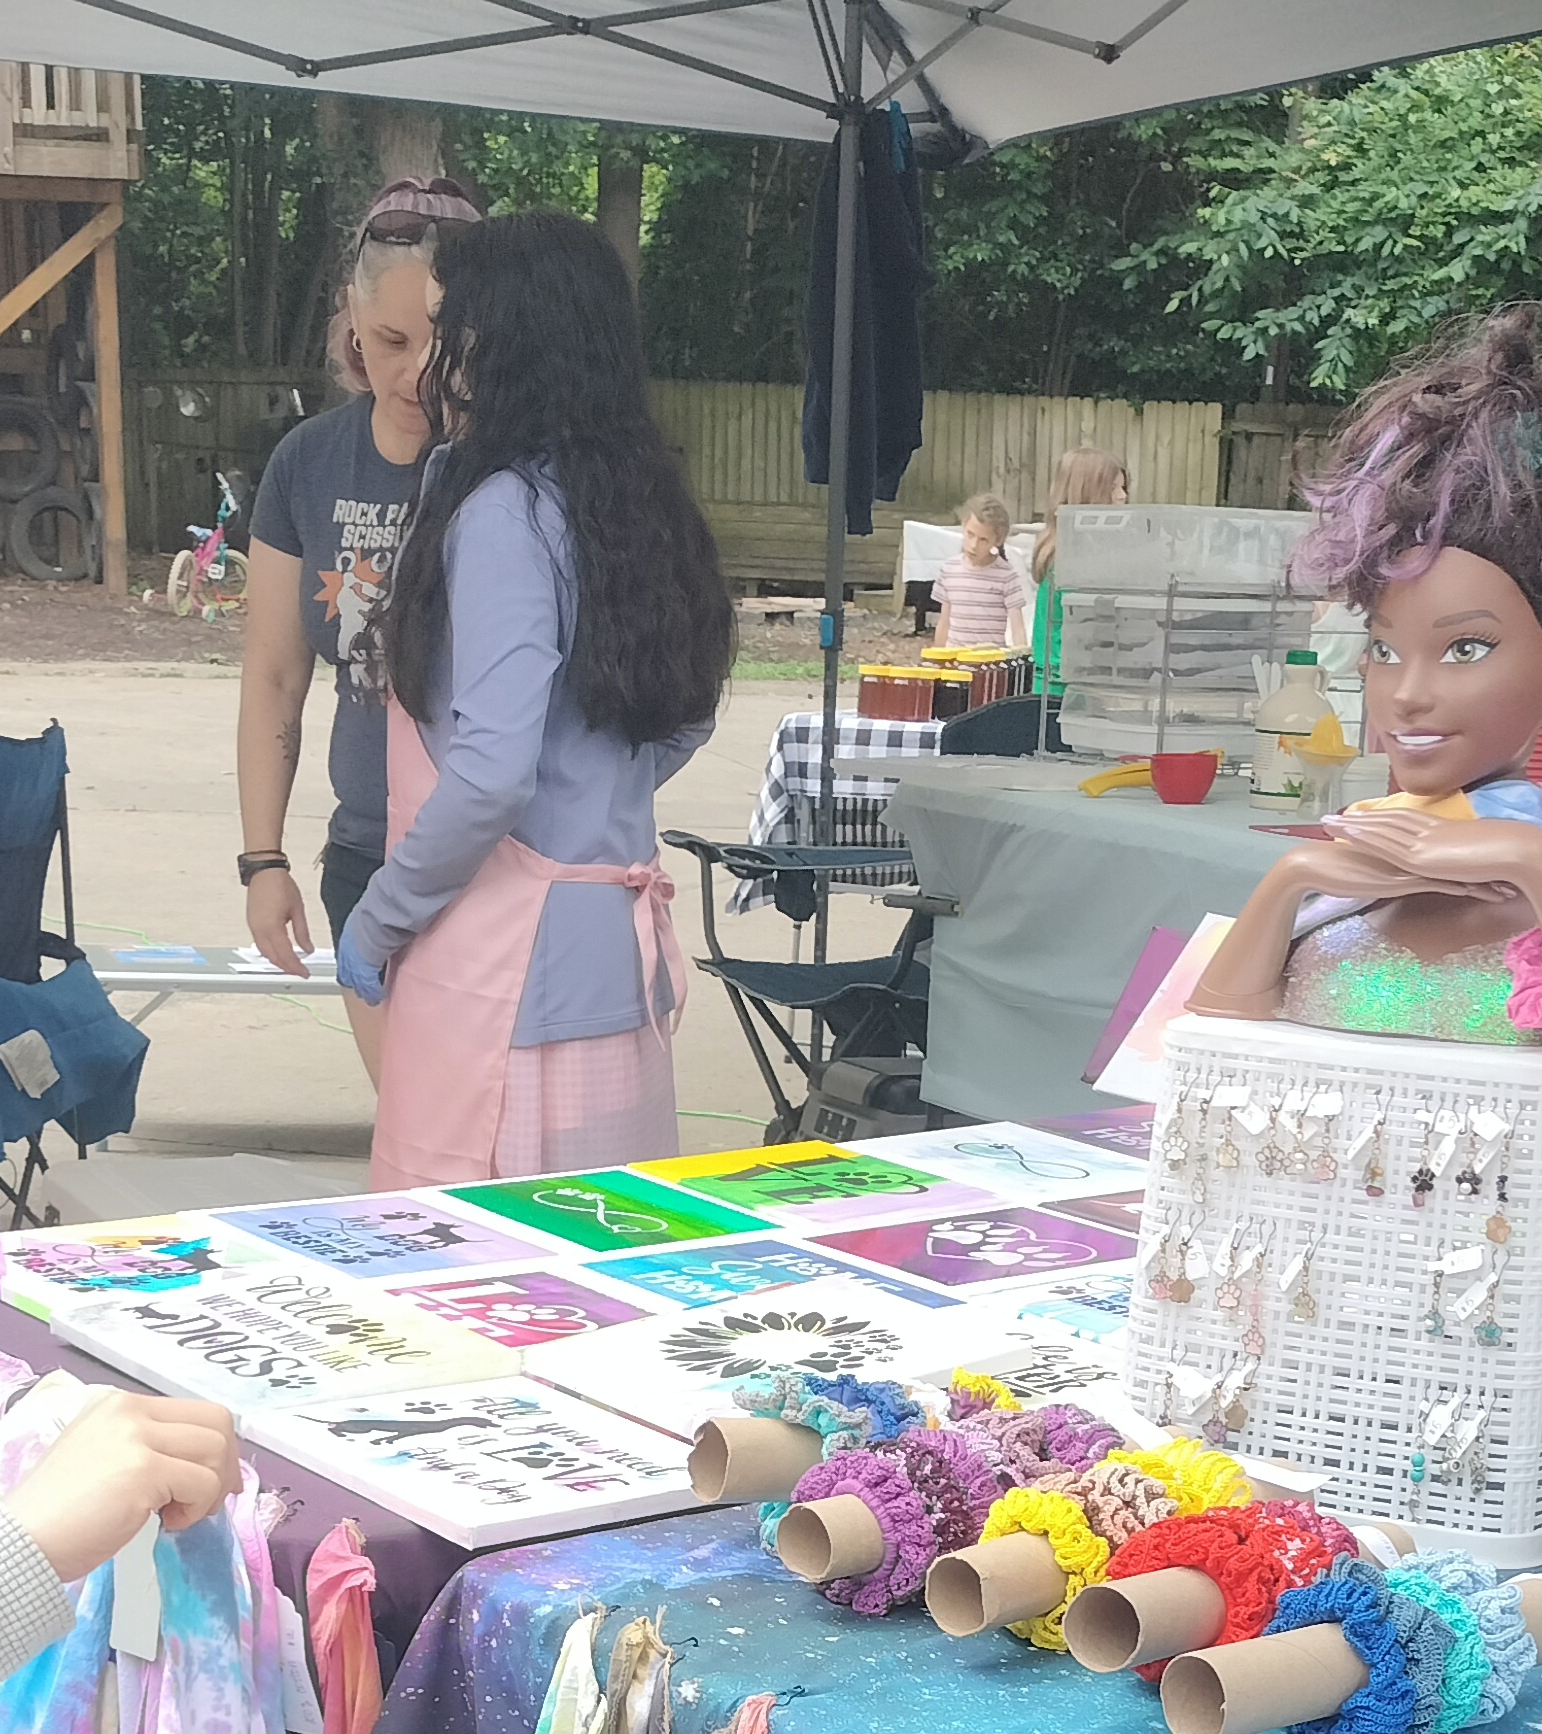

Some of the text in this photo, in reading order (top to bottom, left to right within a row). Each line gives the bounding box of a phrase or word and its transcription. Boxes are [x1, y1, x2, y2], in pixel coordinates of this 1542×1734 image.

[333, 498, 379, 526] ROCK
[270, 1228, 347, 1257] BESTIE
[373, 1232, 429, 1253] DOG
[143, 1313, 309, 1379] DOGS
[197, 1293, 372, 1374] WE HOPE YOU LIKE
[502, 1422, 601, 1448] you
[593, 1449, 690, 1479] need
